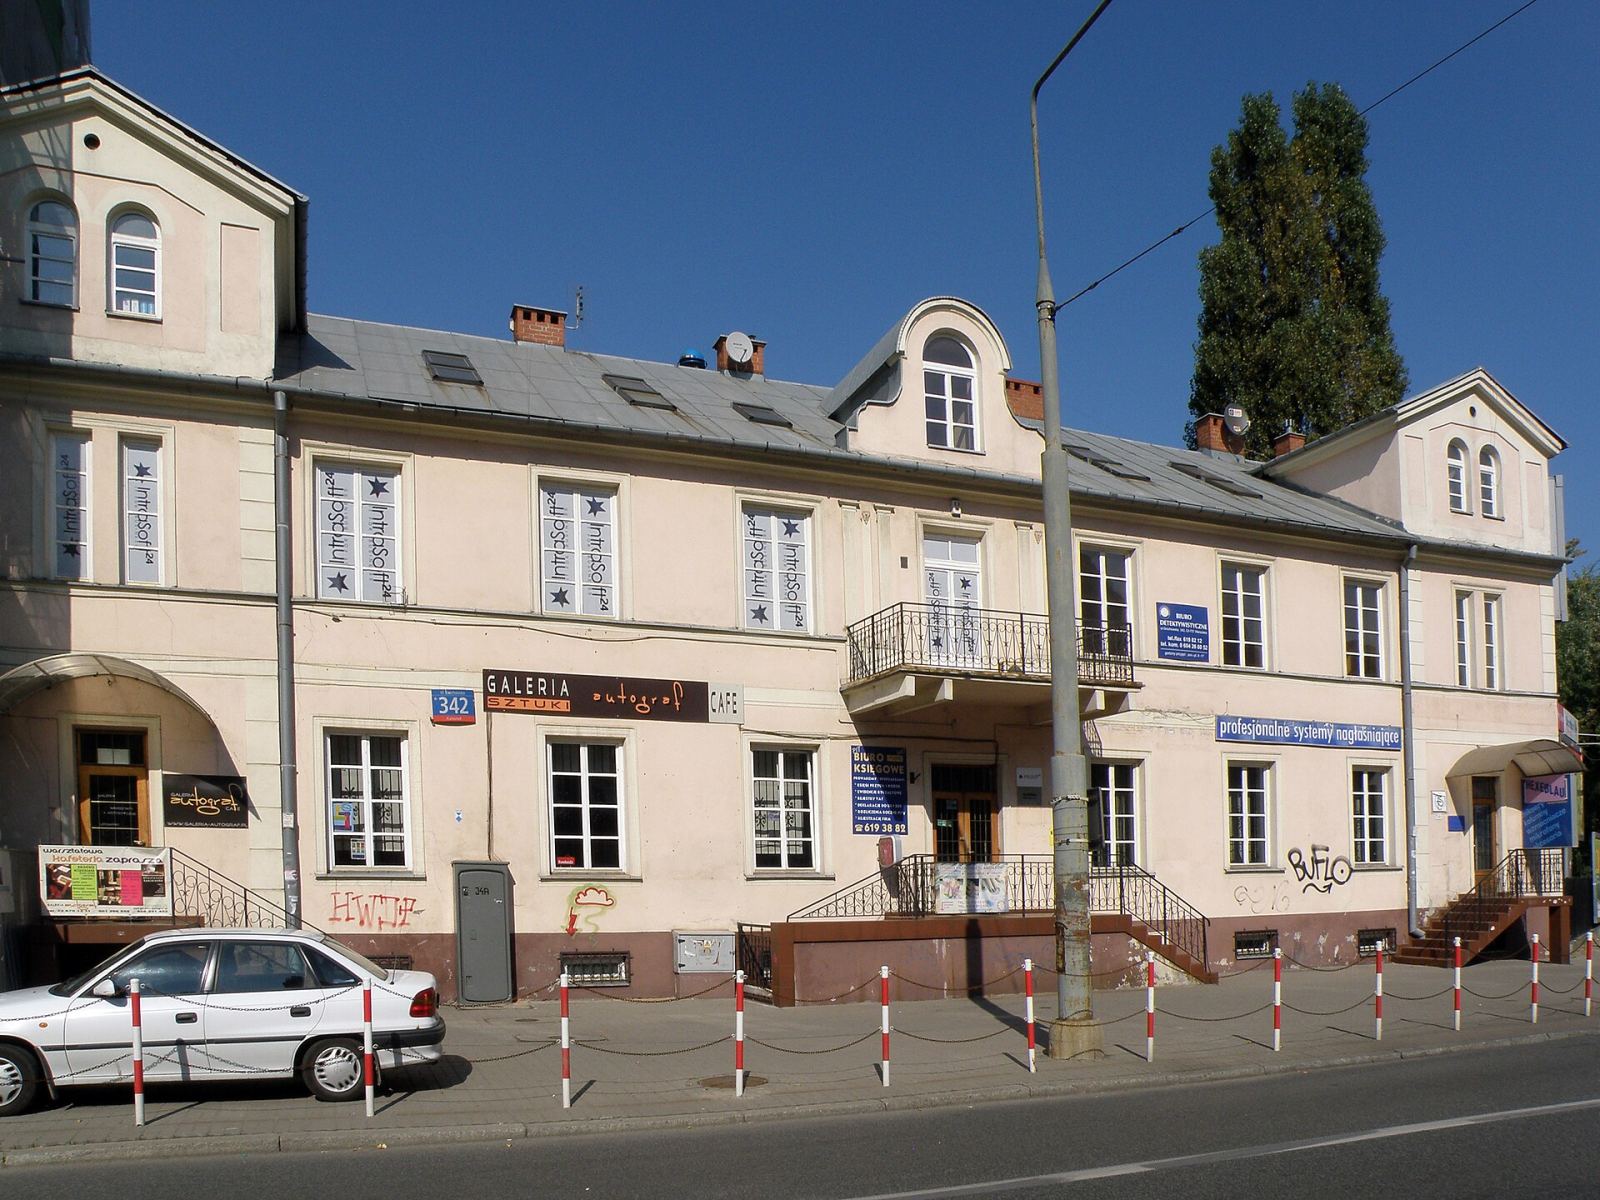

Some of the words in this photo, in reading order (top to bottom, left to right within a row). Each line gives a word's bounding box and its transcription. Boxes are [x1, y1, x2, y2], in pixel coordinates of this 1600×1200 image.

[487, 675, 569, 696] GALERIA
[438, 696, 469, 714] 342
[488, 697, 569, 710] SZTUKI
[592, 681, 684, 713] autograf
[711, 691, 737, 714] CAFE
[1220, 718, 1290, 739] profesjonalne
[1294, 724, 1333, 743] systemy
[853, 752, 884, 761] BIURO
[853, 764, 905, 775] KSIĘGOWE
[170, 783, 243, 815] autograf
[864, 823, 880, 832] 619
[881, 823, 893, 832] 38
[894, 823, 906, 833] 82
[105, 856, 163, 864] zaprasza
